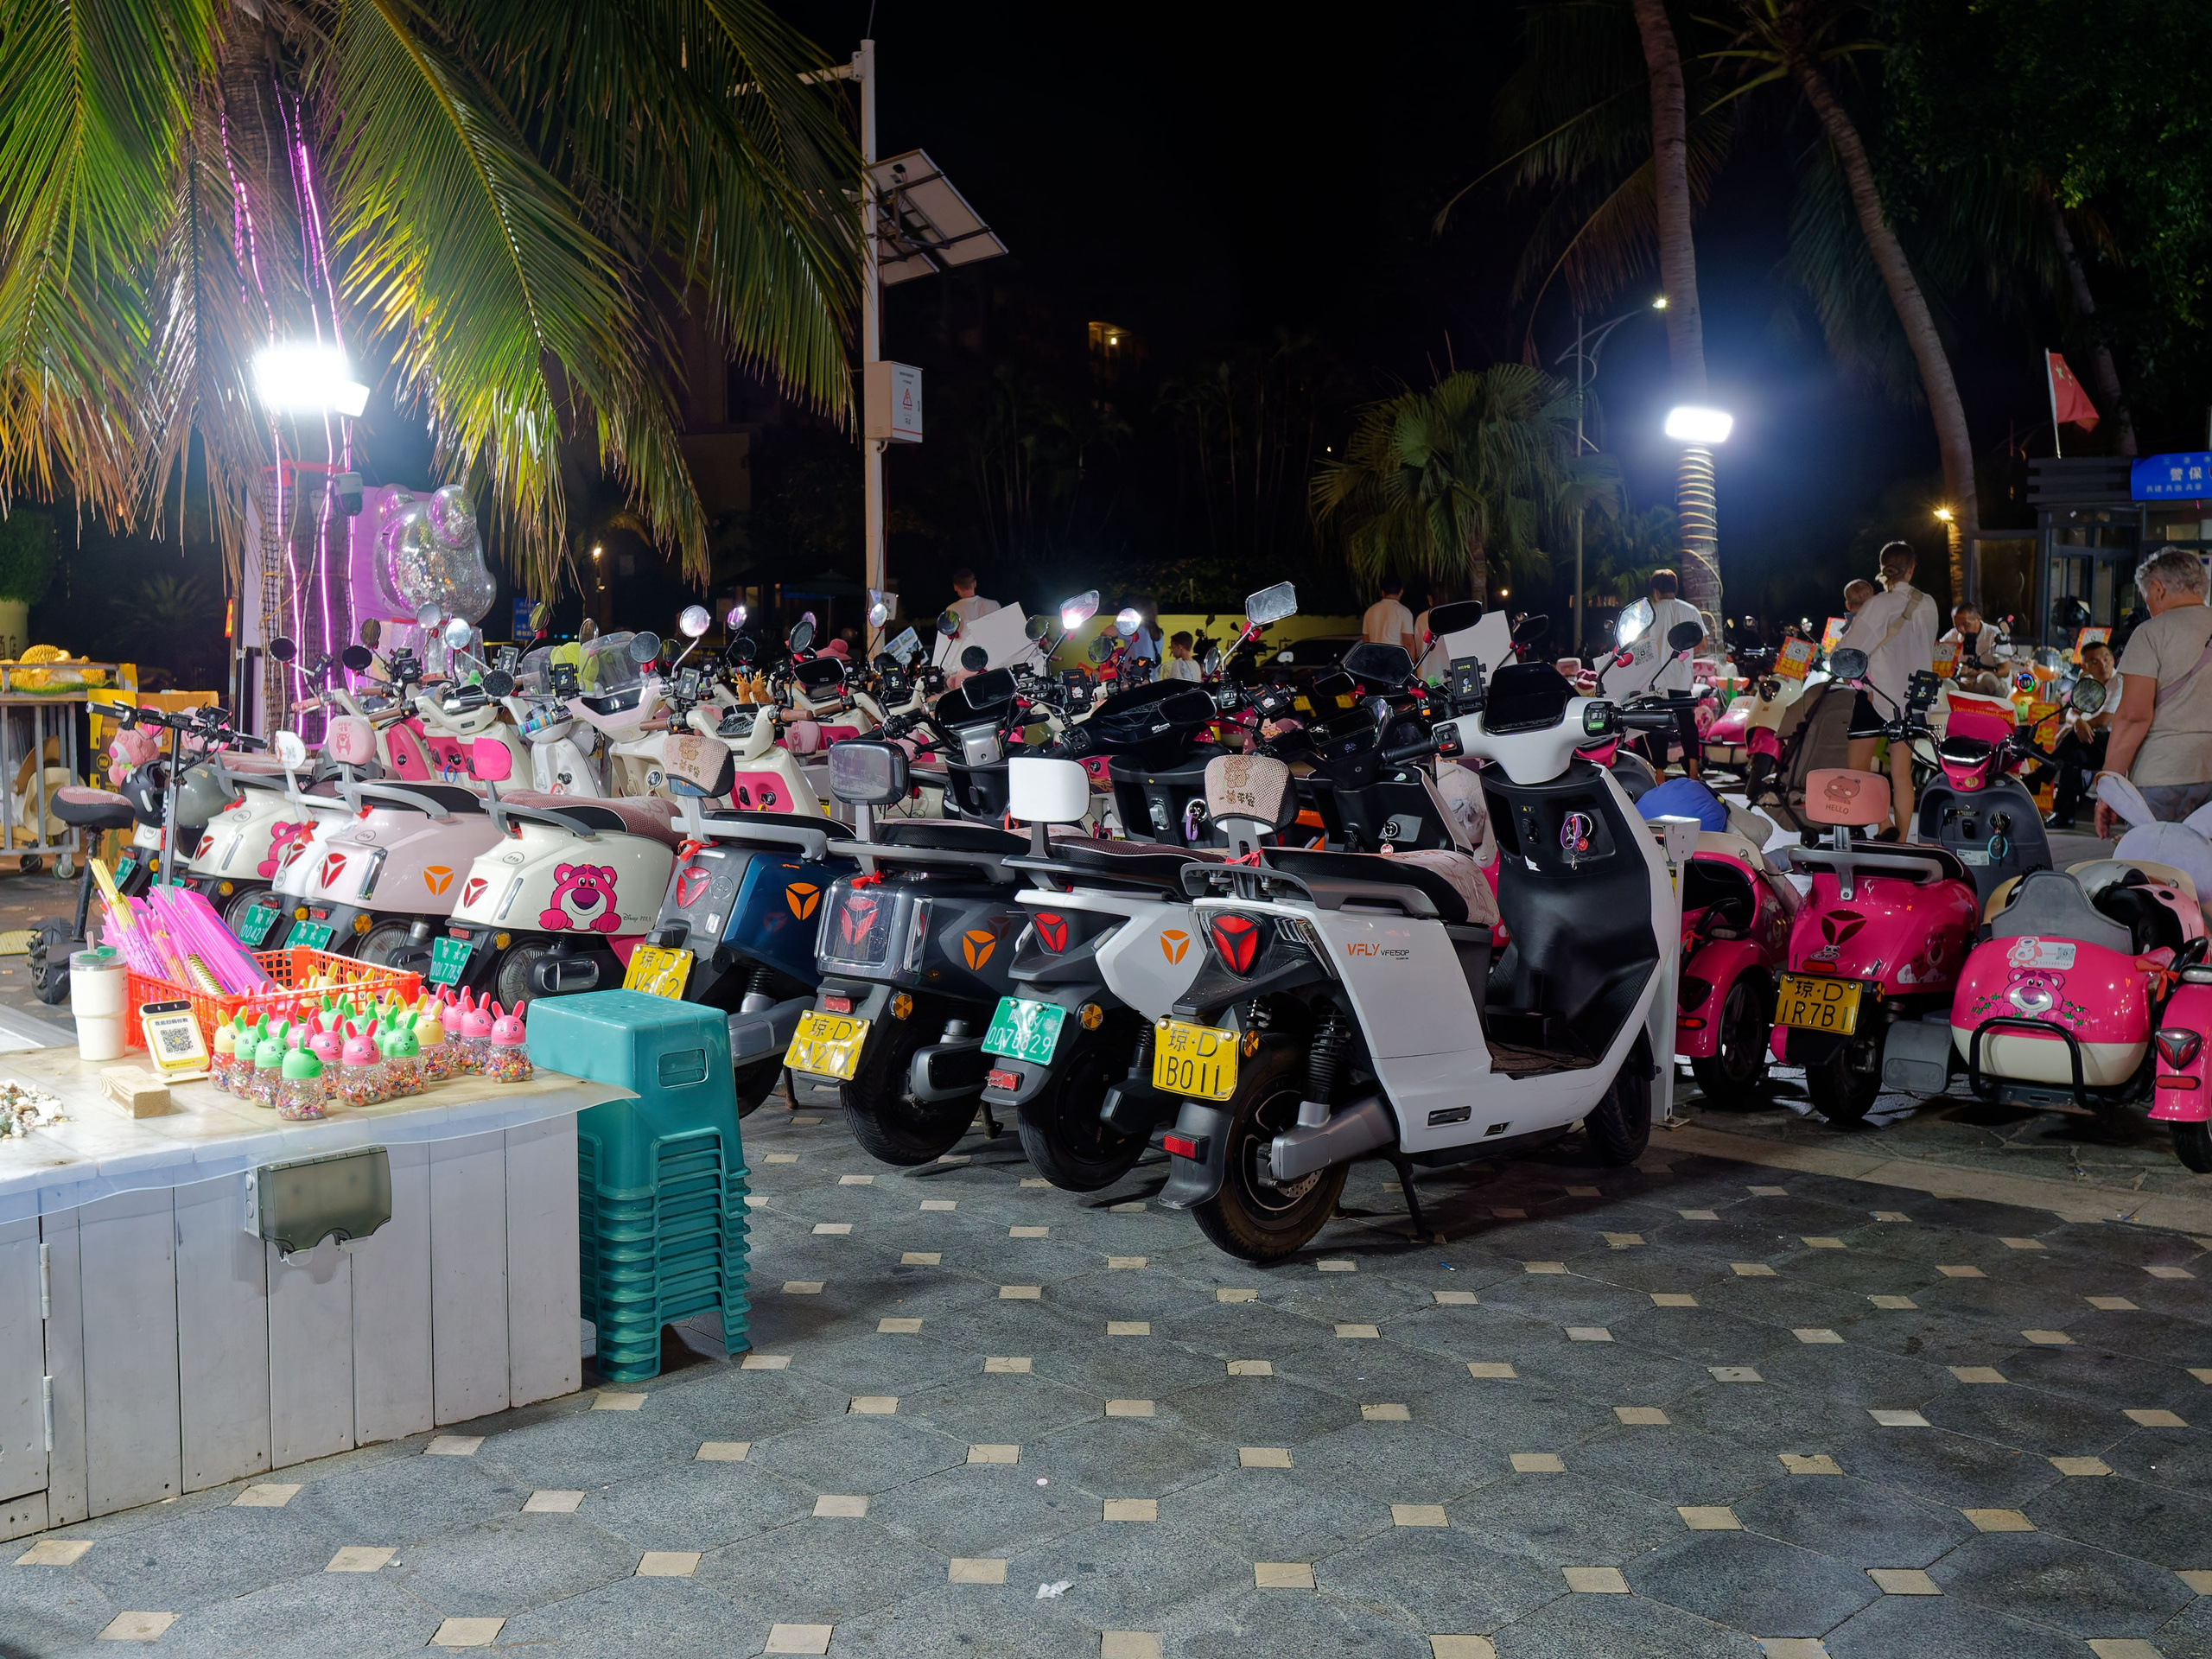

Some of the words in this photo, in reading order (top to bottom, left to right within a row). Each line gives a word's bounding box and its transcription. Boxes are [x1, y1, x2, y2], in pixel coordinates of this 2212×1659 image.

[1825, 804, 1849, 815] HELLO
[1347, 944, 1380, 956] VFLY
[1795, 980, 1843, 1001] 琼·D
[1782, 999, 1848, 1030] 1R7B1
[810, 1019, 852, 1040] 琼·D
[1168, 1028, 1218, 1057] 琼·D
